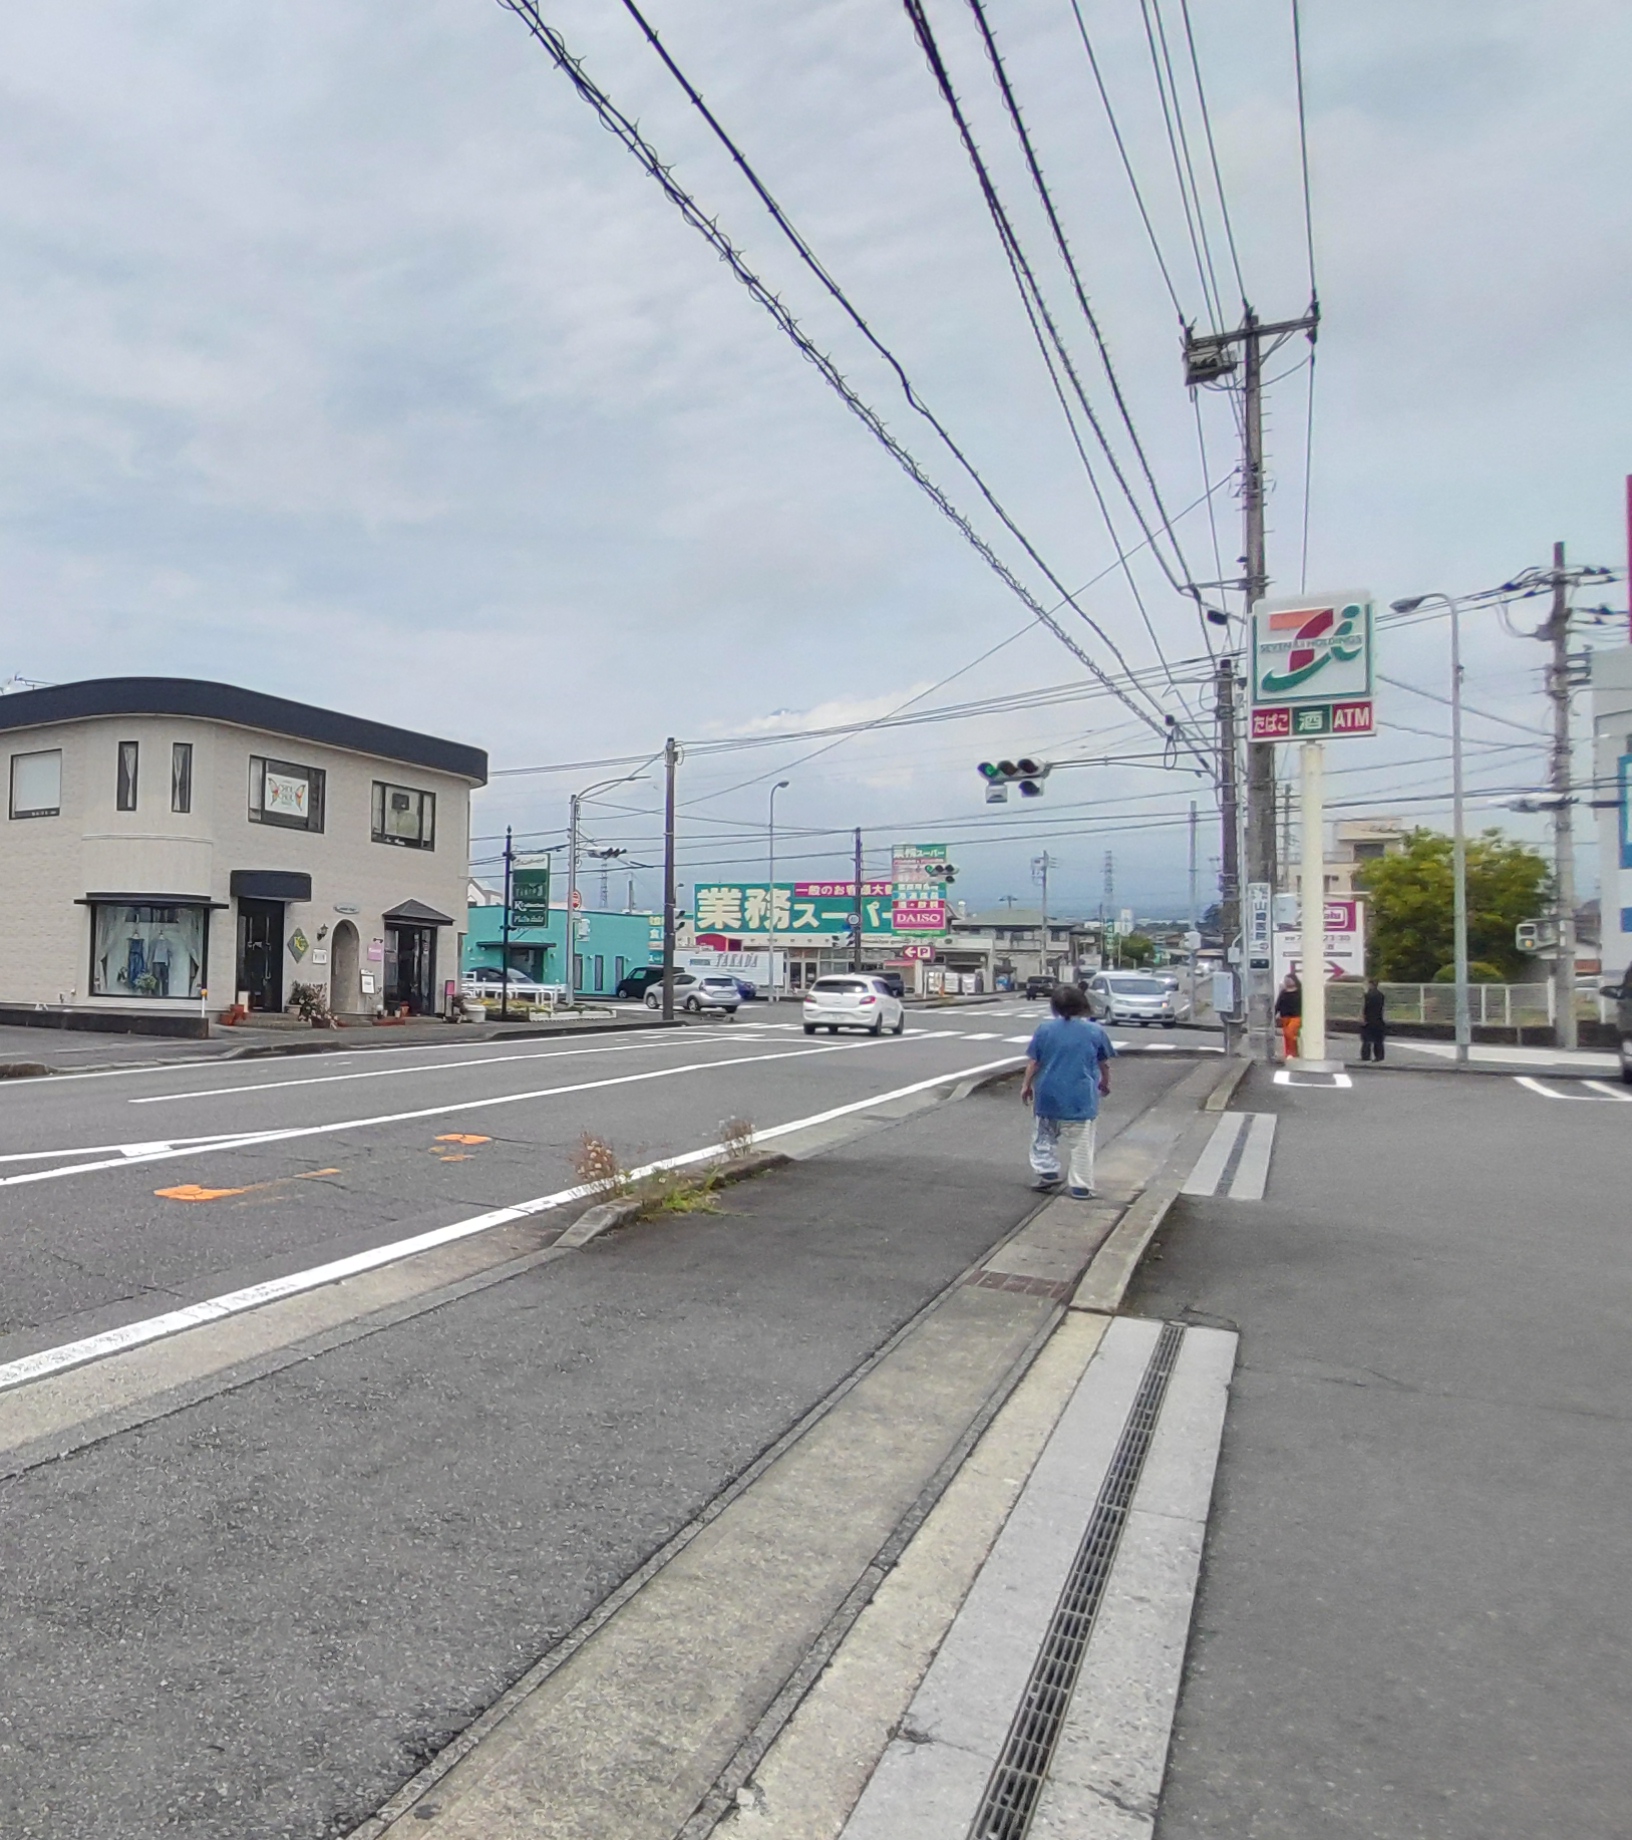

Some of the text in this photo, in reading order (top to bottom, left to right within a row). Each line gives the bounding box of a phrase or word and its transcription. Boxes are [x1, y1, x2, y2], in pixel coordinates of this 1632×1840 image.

[1254, 714, 1289, 733] たばこ
[1298, 710, 1323, 732] 酒
[1334, 707, 1369, 728] ATM
[896, 913, 941, 922] DAISO
